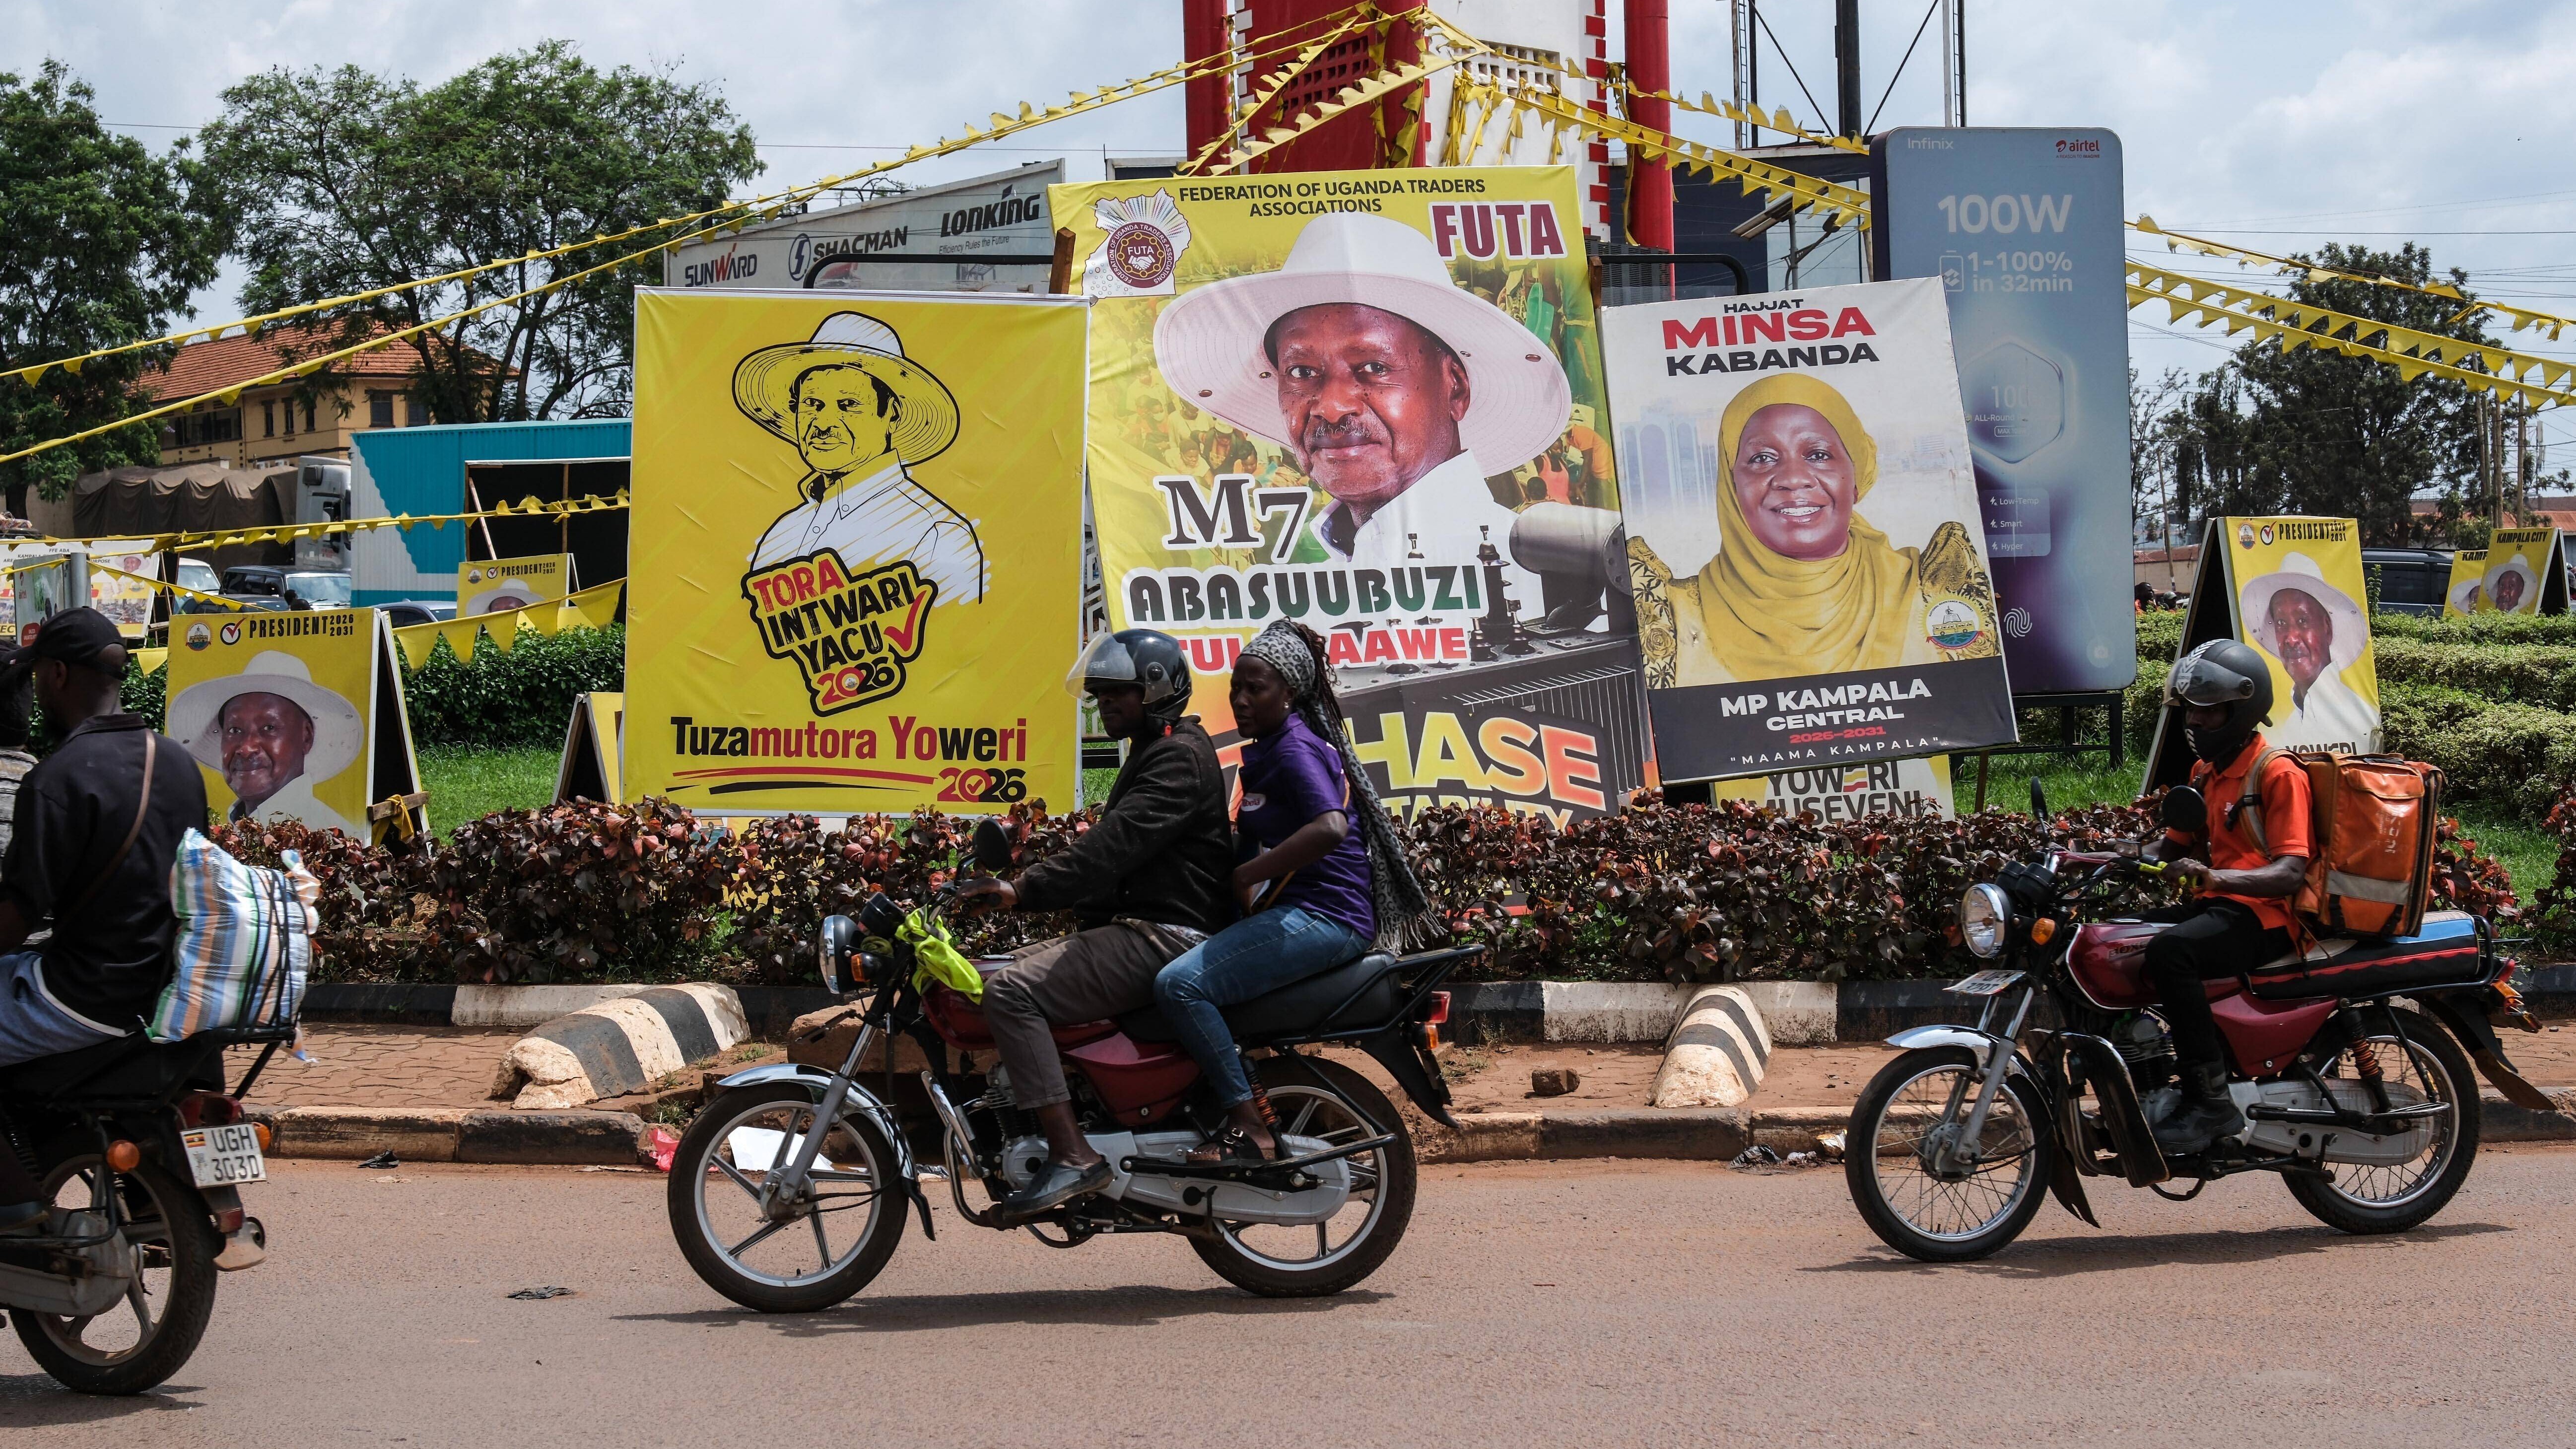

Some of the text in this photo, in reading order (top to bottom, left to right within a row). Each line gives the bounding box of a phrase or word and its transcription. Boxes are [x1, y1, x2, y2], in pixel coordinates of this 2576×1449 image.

[1907, 137, 1954, 150] Infinix
[2069, 139, 2100, 151] airtel
[1180, 179, 1486, 202] FEDERATION OF UGANDA TRADERS
[1250, 199, 1382, 217] ASSOCIATIONS
[1938, 194, 2073, 233] 100W
[1432, 204, 1565, 257] FUTA
[813, 225, 908, 263] SHACMAN
[939, 235, 1010, 254] Efficiency Rules the Future
[1109, 224, 1173, 284] FEDERATION OF UGANDA TRADERS ASSOCIATIONS
[1127, 245, 1154, 255] FUTA
[684, 242, 757, 287] SUNWARD
[1967, 251, 2073, 272] 1-100%
[1973, 274, 2073, 292] in 32min
[1724, 298, 1804, 314] HAJJAT
[1662, 306, 1877, 350] MINSA
[1666, 343, 1880, 376] KABANDA
[2279, 522, 2346, 540] PRESIDENT 2026
[2330, 533, 2347, 542] 2031
[2497, 531, 2548, 544] KAMPALA CITY
[2001, 543, 2024, 551] Hyper
[501, 563, 542, 576] PRESIDENT
[752, 558, 845, 613] TORA
[1129, 565, 1482, 621] ABASUUBUZI
[767, 571, 915, 648] INTWARI
[249, 614, 354, 638] PRESIDENT 2026
[330, 625, 354, 636] 2031
[798, 620, 883, 674] YACU
[816, 656, 895, 706] 2026
[1720, 678, 1932, 717] MP KAMPALA
[1766, 705, 1905, 731] CENTRAL
[670, 716, 1027, 761] Tuzamutora Yoweri
[1789, 726, 1887, 744] 2026-2031
[1340, 711, 1606, 812] HASE
[937, 767, 1027, 804] 2026
[211, 1126, 254, 1153] UGH
